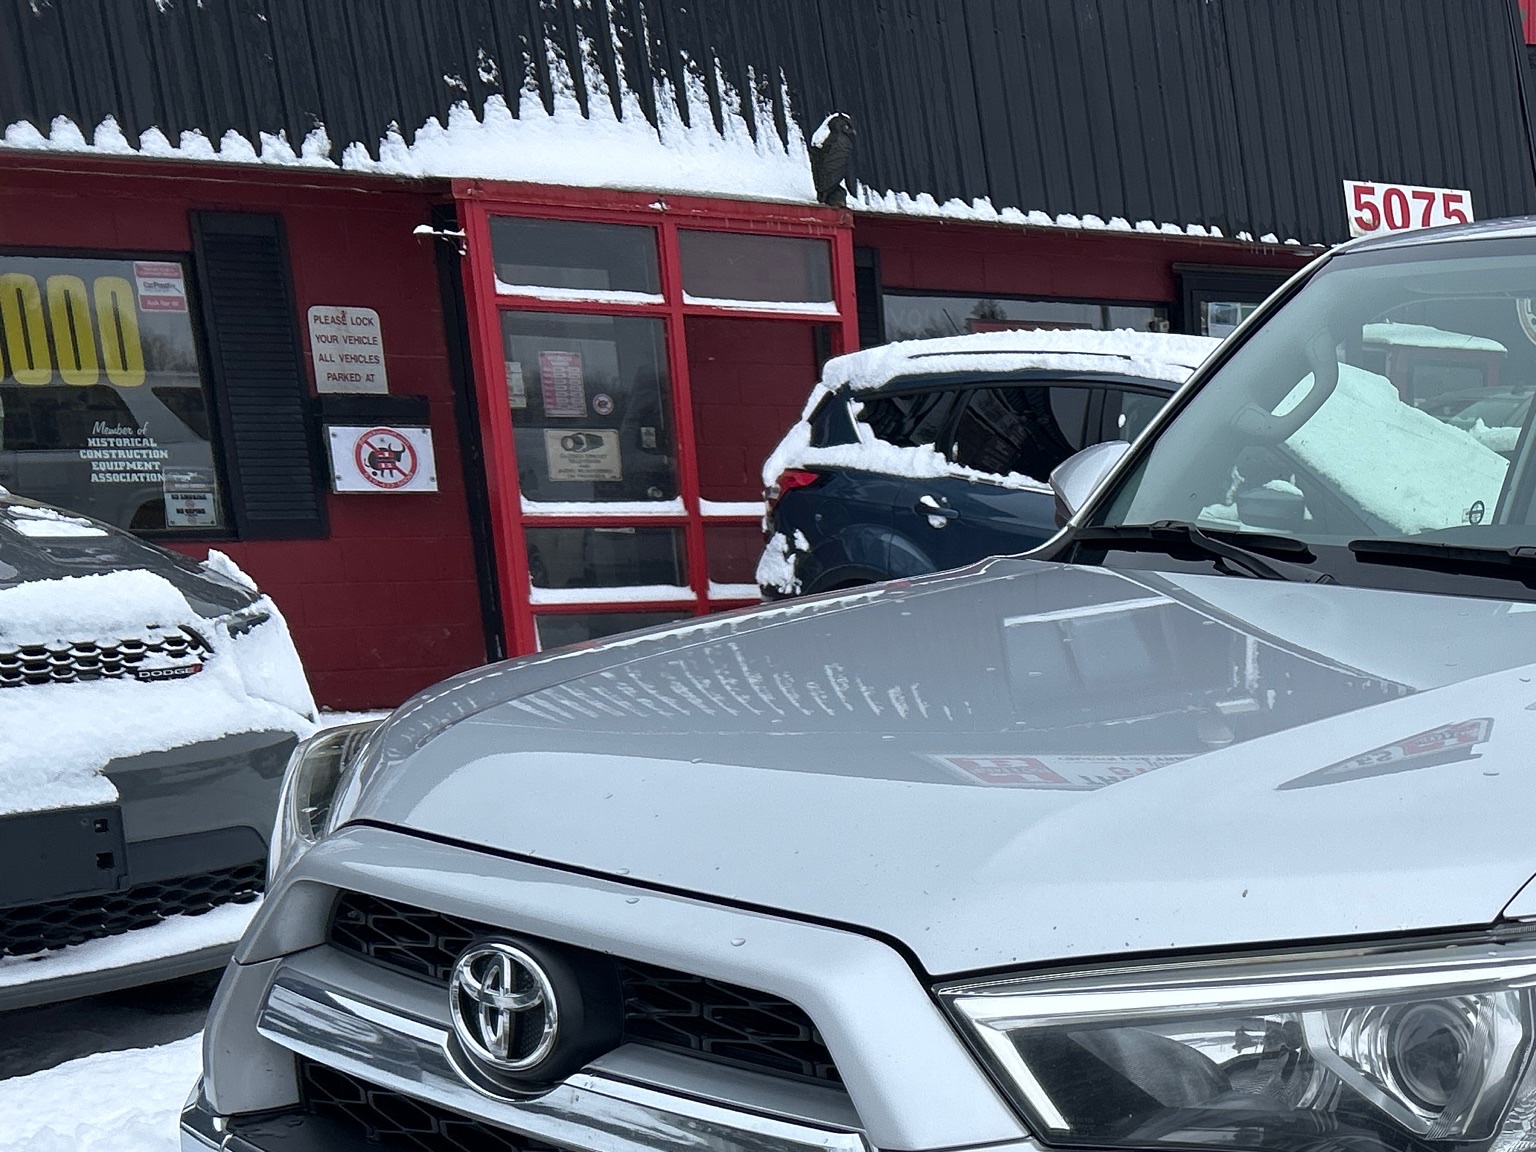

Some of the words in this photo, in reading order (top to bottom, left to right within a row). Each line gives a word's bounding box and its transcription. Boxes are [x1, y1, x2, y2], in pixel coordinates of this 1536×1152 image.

[1353, 185, 1469, 231] 5075
[313, 315, 348, 326] PLEASE
[350, 316, 375, 326] LOCK
[0, 273, 146, 388] 000
[315, 334, 339, 344] YOUR
[342, 335, 379, 346] VEHICLE
[318, 353, 335, 363] ALL
[338, 354, 380, 364] VEHICLES
[326, 372, 362, 383] PARKED
[365, 373, 376, 383] AT
[92, 421, 133, 436] Member
[136, 421, 150, 435] of
[87, 437, 158, 448] HISTORICAL
[79, 449, 169, 459] CONSTRUCTION
[91, 461, 161, 471] EQUIPMENT
[90, 473, 166, 483] ASSOCIATION
[139, 667, 194, 678] DODGE
